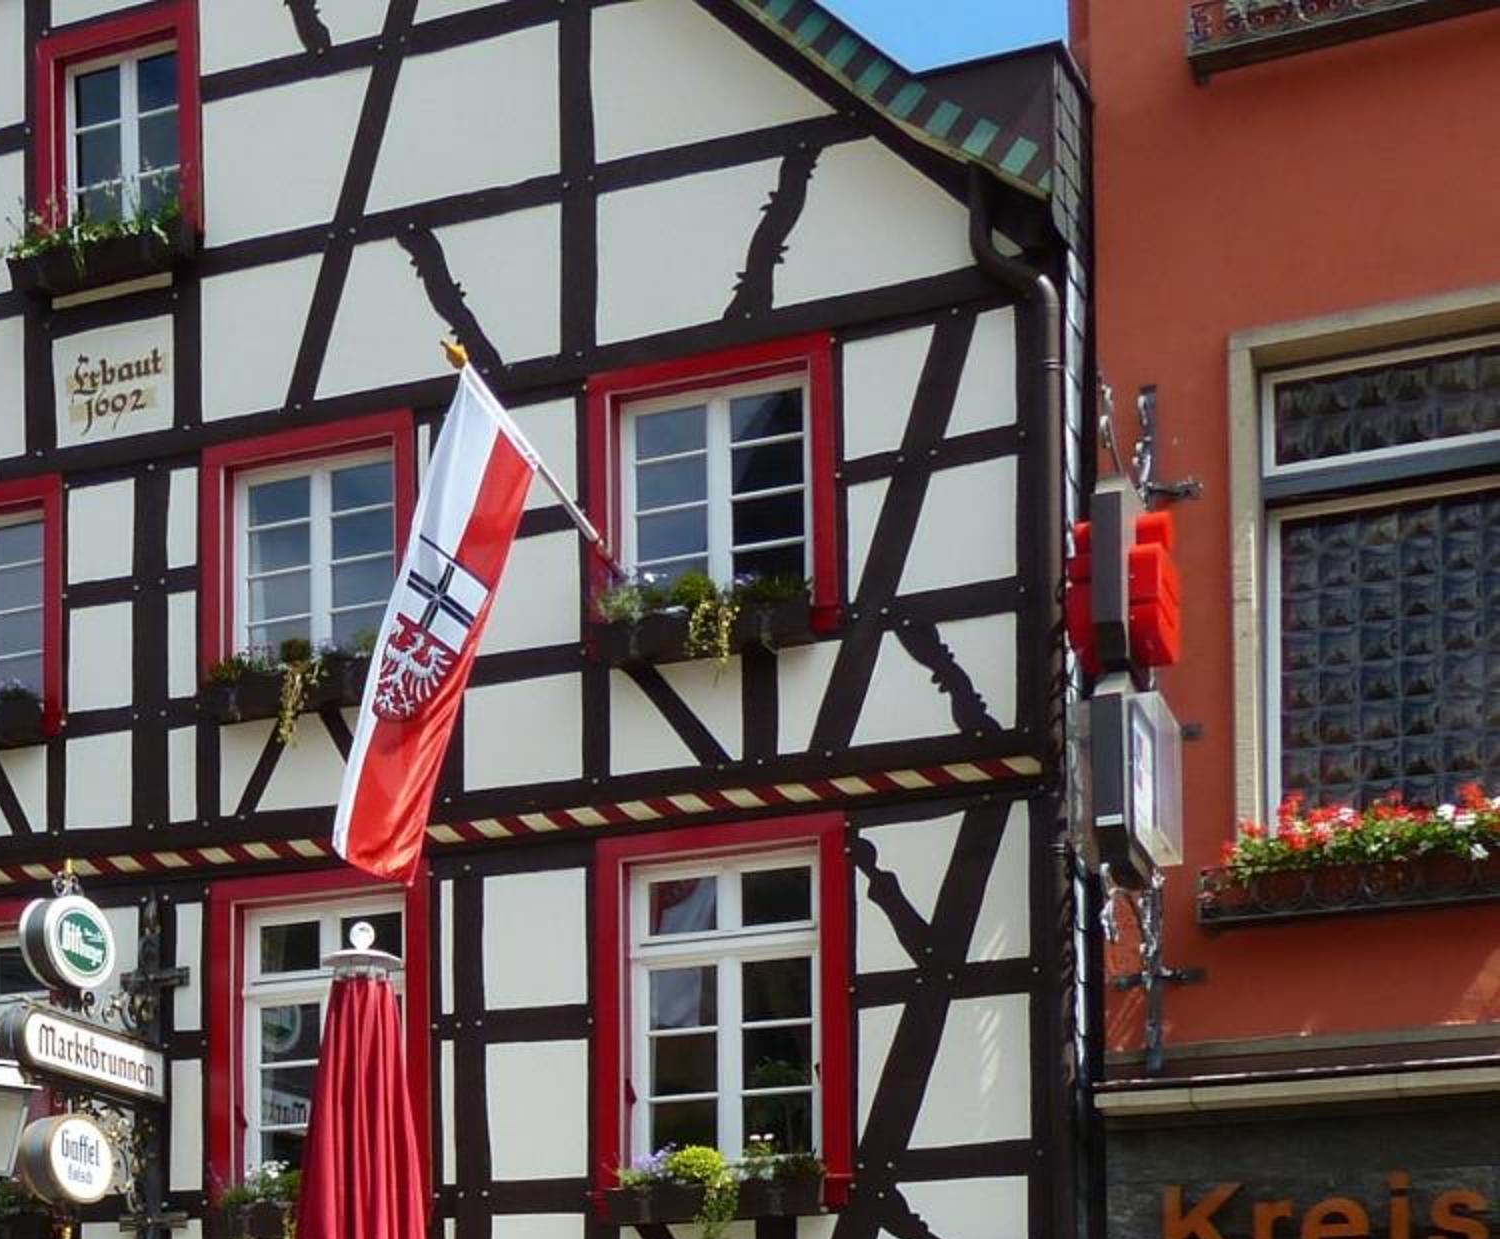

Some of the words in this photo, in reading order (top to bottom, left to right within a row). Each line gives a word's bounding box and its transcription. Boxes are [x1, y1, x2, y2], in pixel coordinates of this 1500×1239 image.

[72, 348, 162, 397] Erbaut
[82, 389, 146, 436] 1692
[38, 1022, 156, 1089] Marktbrunnen
[61, 1129, 100, 1167] Gaffel
